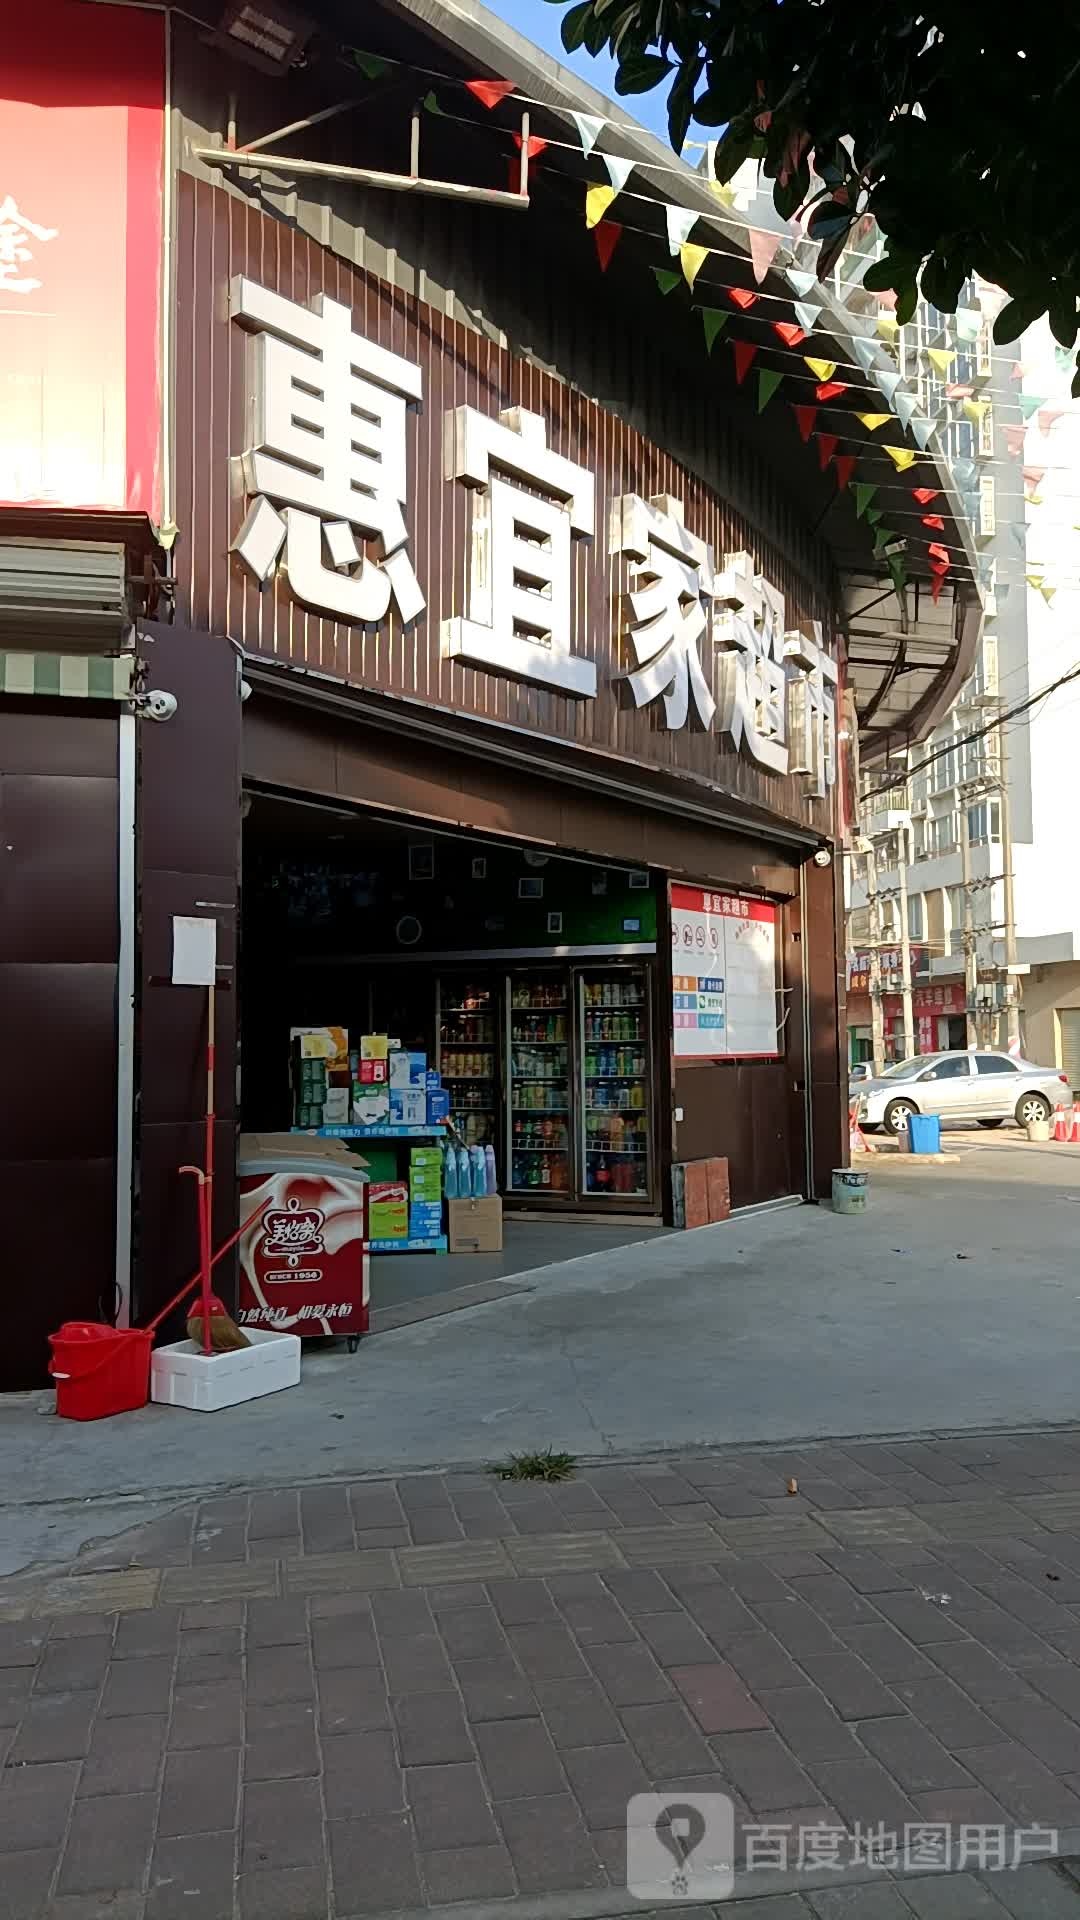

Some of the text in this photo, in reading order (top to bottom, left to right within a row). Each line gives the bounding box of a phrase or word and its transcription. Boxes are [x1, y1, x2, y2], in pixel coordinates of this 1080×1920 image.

[229, 273, 838, 799] 惠宜家超市
[702, 892, 750, 917] 惠宜家超市
